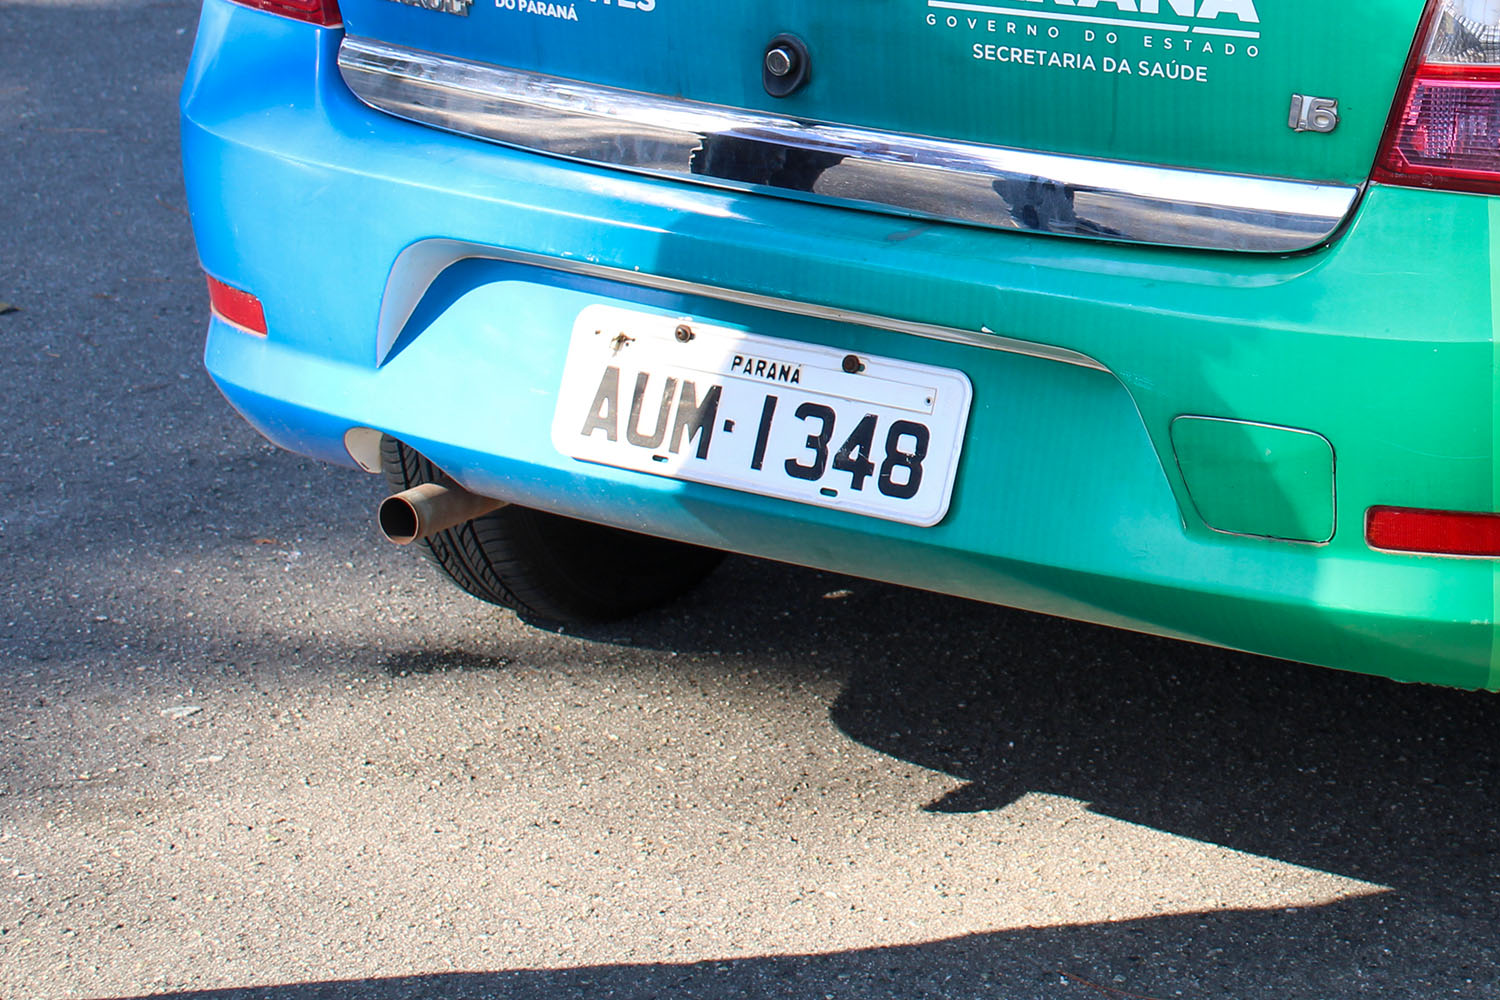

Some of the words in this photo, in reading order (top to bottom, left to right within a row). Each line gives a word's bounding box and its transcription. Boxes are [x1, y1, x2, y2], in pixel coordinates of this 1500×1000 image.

[518, 0, 578, 21] PARANÁ
[926, 13, 1060, 38] GOVERNO
[1085, 29, 1118, 44] DO
[1144, 36, 1260, 57] ESTADO
[972, 43, 1096, 71] SECRETARIA
[1102, 56, 1131, 74] DA
[1138, 59, 1208, 83] SAÚDE
